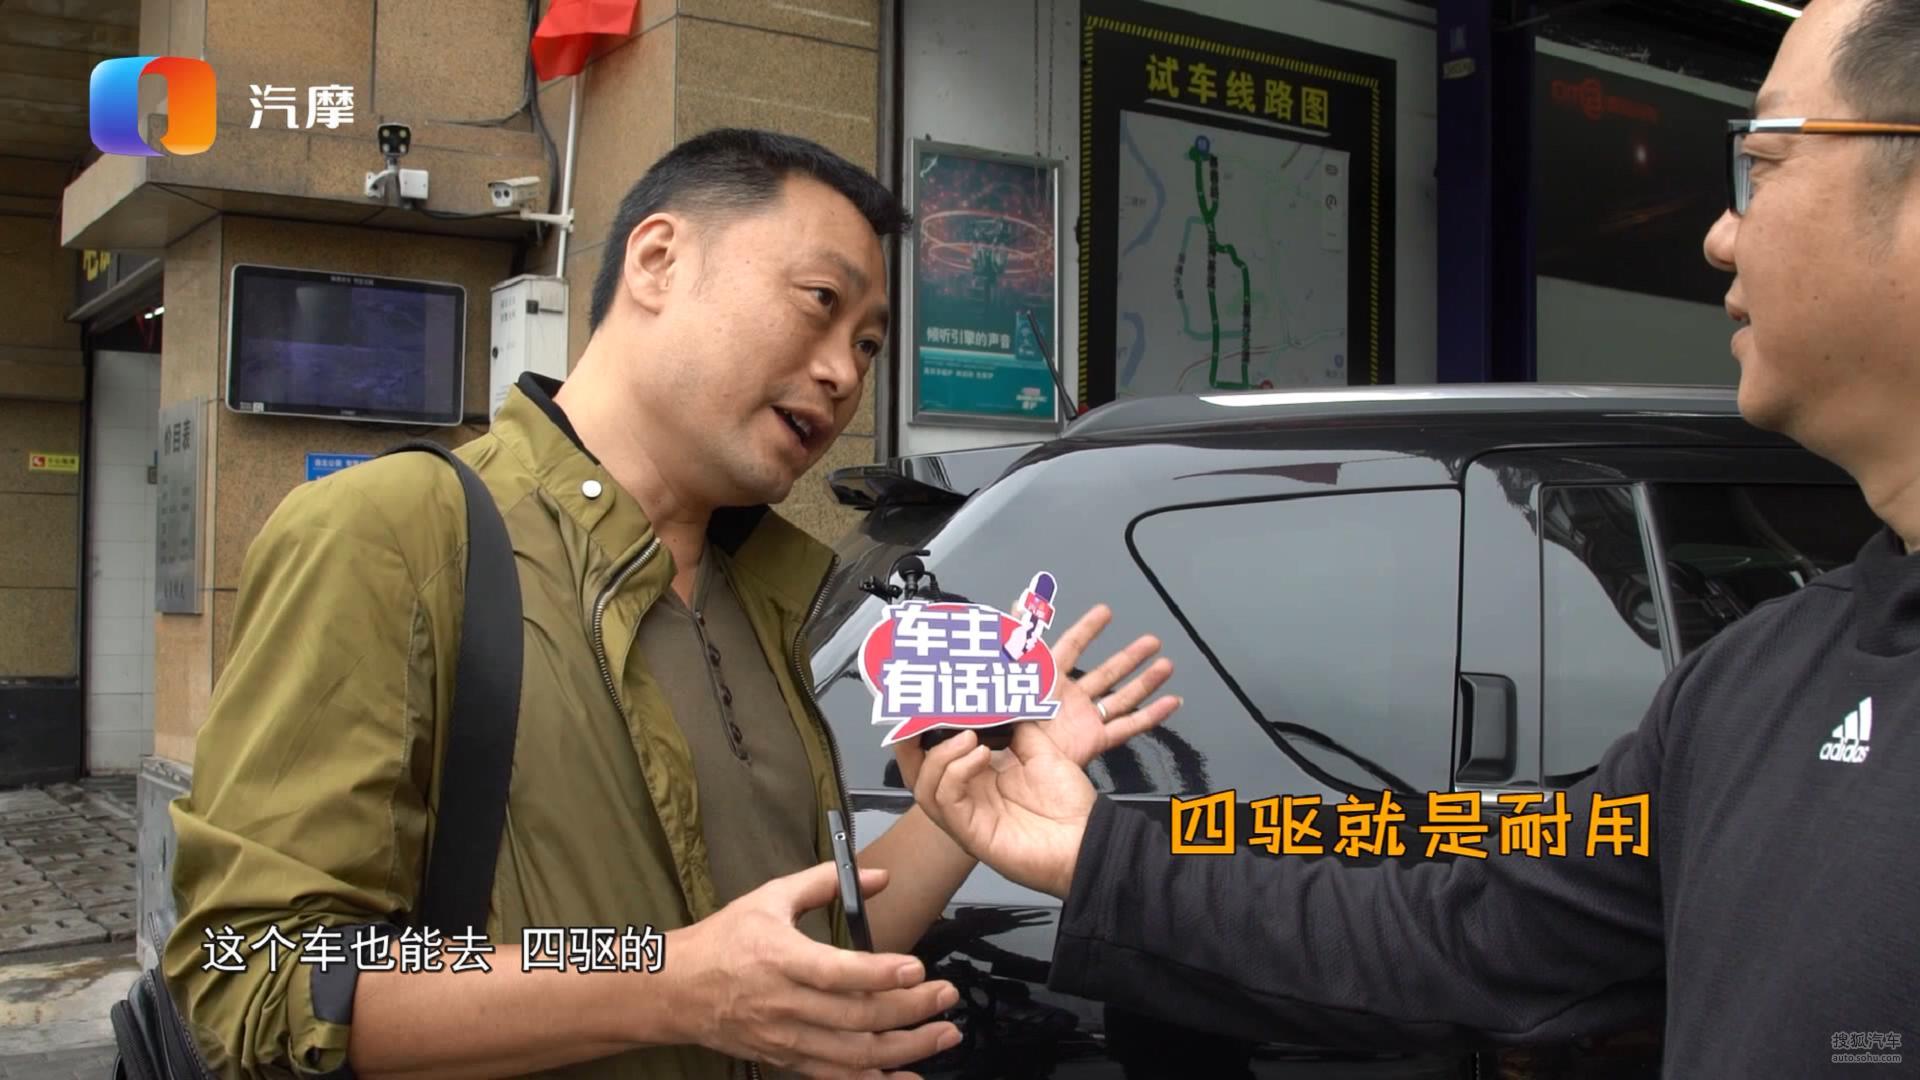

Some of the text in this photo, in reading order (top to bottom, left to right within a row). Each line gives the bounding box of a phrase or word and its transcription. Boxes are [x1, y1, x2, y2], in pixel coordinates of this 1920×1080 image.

[1145, 54, 1329, 129] 试车线路图
[927, 326, 1011, 349] 倾听引擎的声音
[894, 604, 1001, 657] 车主
[884, 660, 1055, 713] 有话说
[1819, 737, 1870, 763] adidas
